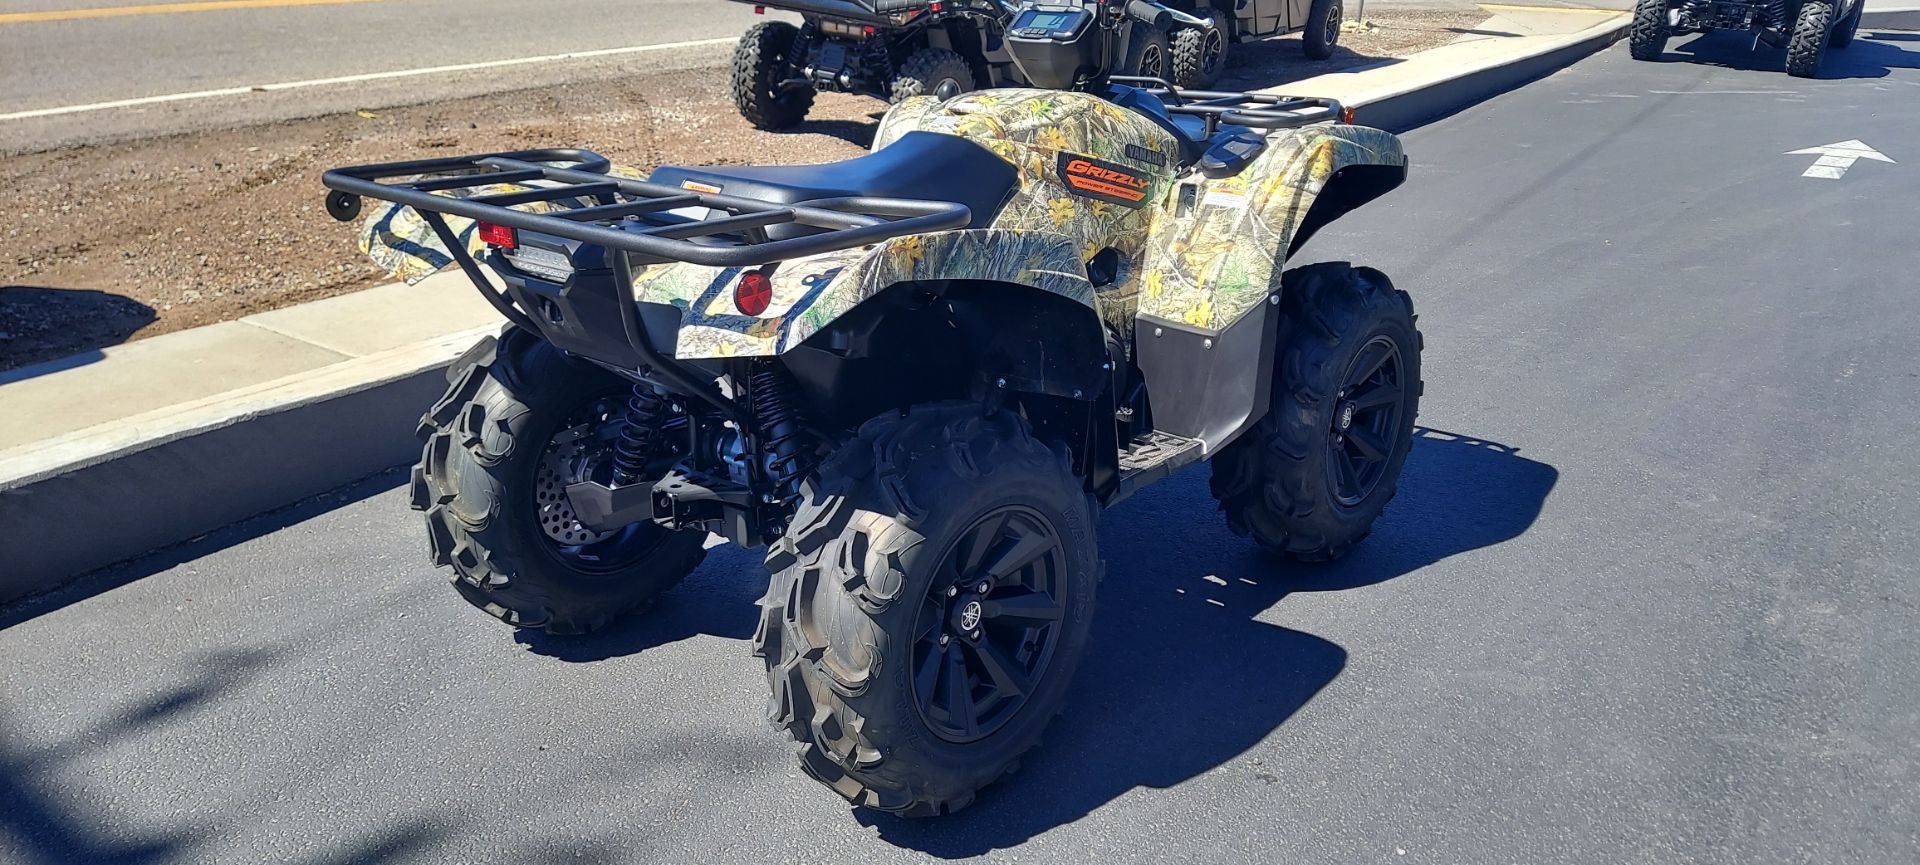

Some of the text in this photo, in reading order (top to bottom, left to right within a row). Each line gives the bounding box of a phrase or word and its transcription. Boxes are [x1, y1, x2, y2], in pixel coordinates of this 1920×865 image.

[1129, 144, 1163, 165] YAMAHA
[1066, 159, 1150, 189] GRIZZLY
[1076, 180, 1104, 189] POWER
